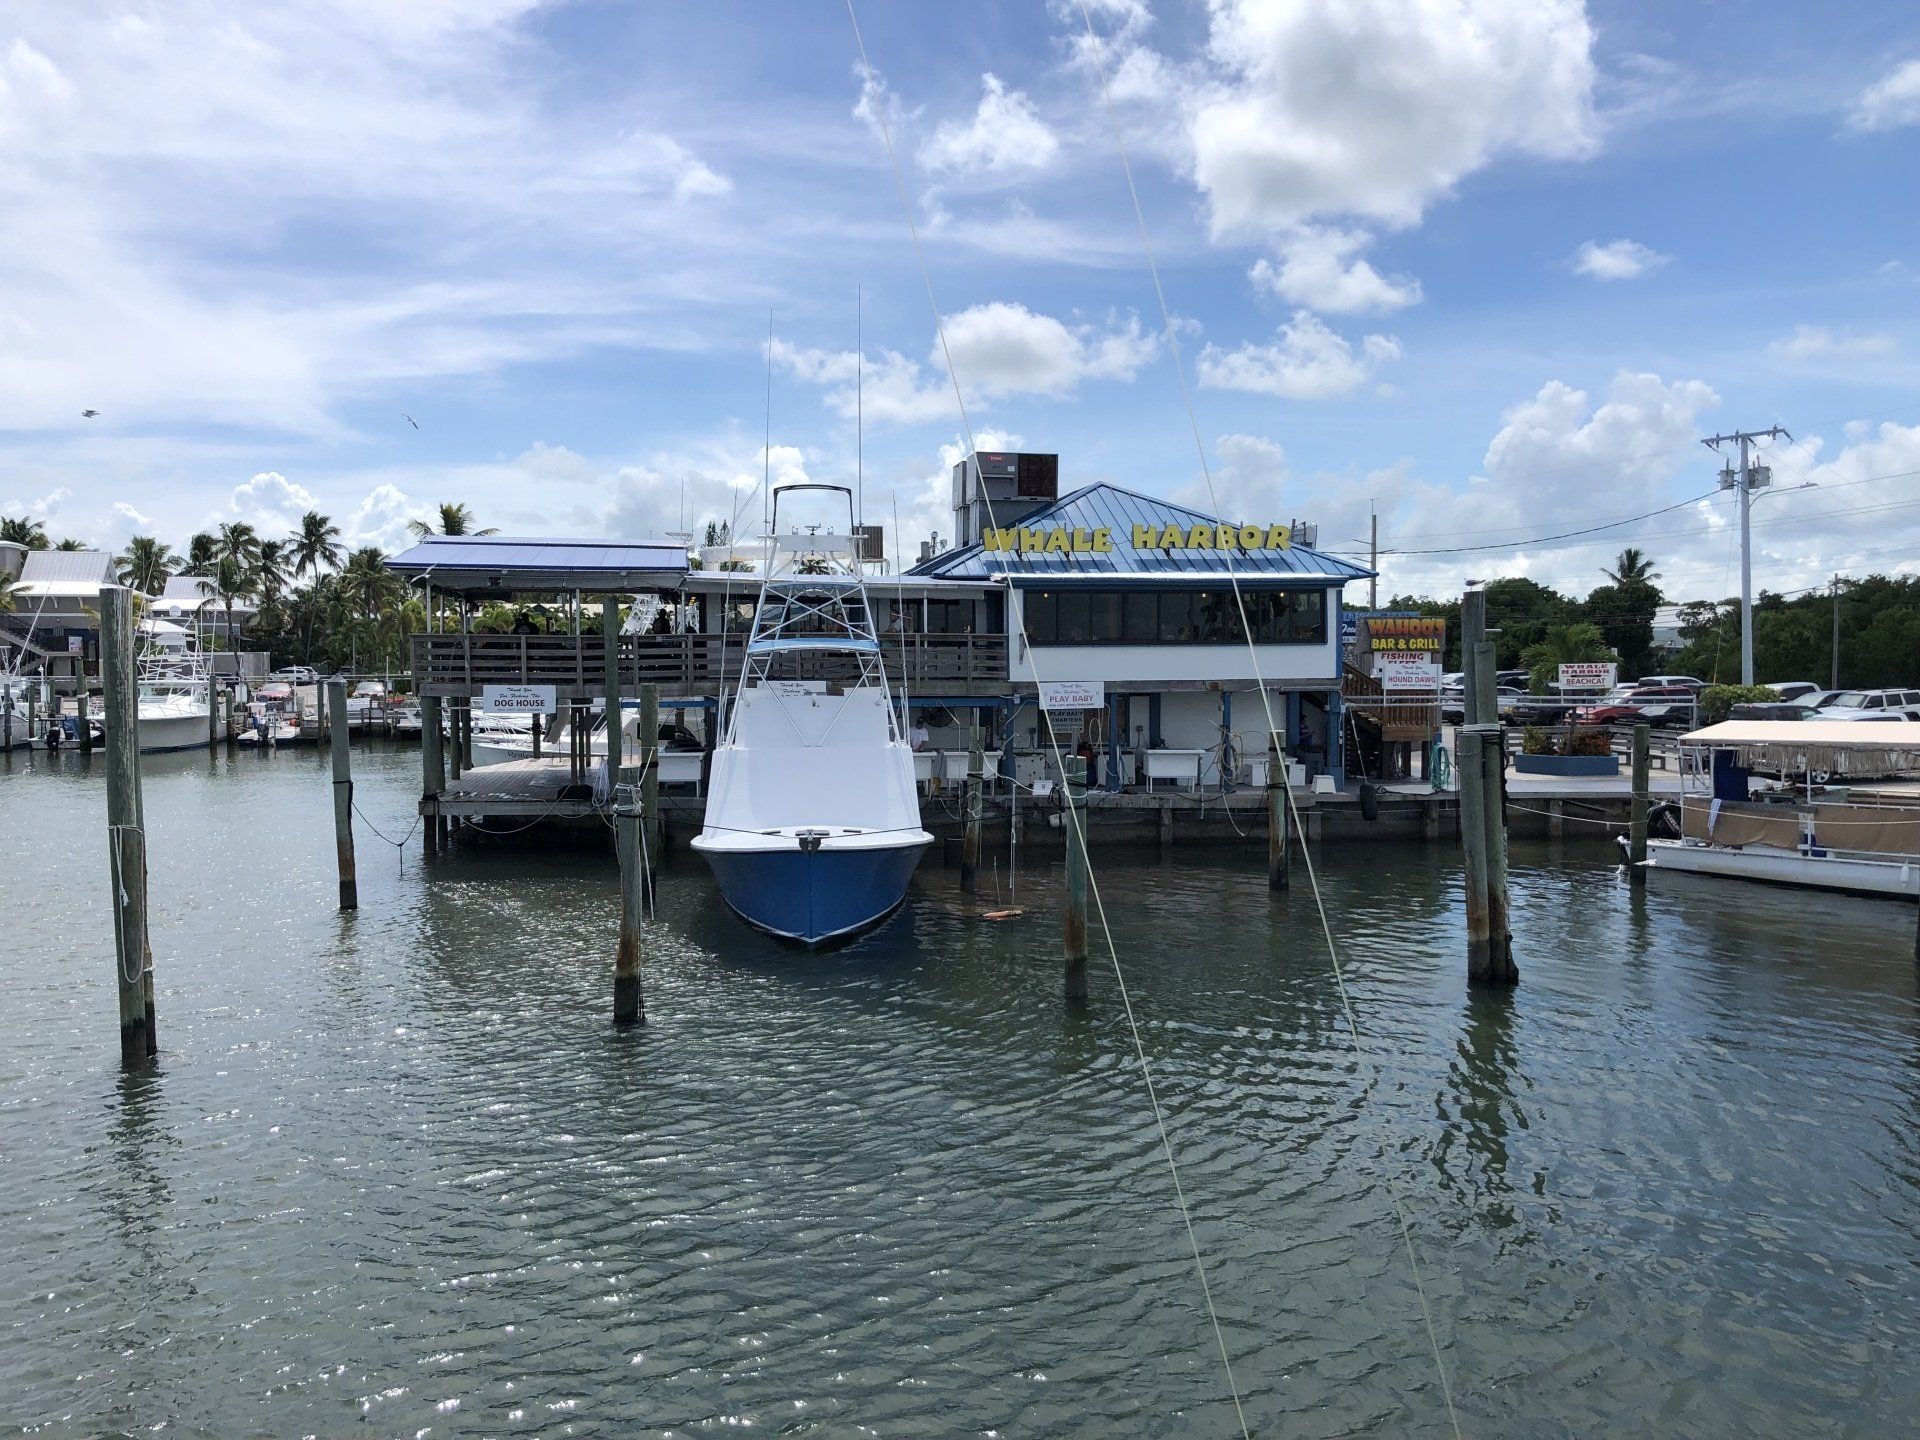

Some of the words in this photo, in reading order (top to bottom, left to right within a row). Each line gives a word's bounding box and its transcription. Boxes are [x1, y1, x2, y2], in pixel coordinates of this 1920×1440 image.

[983, 526, 1112, 553] WHALE
[1132, 524, 1293, 551] HARBOR
[1371, 638, 1395, 649] BAR
[1397, 638, 1407, 649] &
[1409, 638, 1440, 649] GRILL
[1381, 652, 1424, 661] FISHING
[494, 699, 514, 707] DOG
[516, 699, 546, 707] HOUSE
[1049, 695, 1070, 703] PLAY
[1072, 695, 1094, 703] BABY
